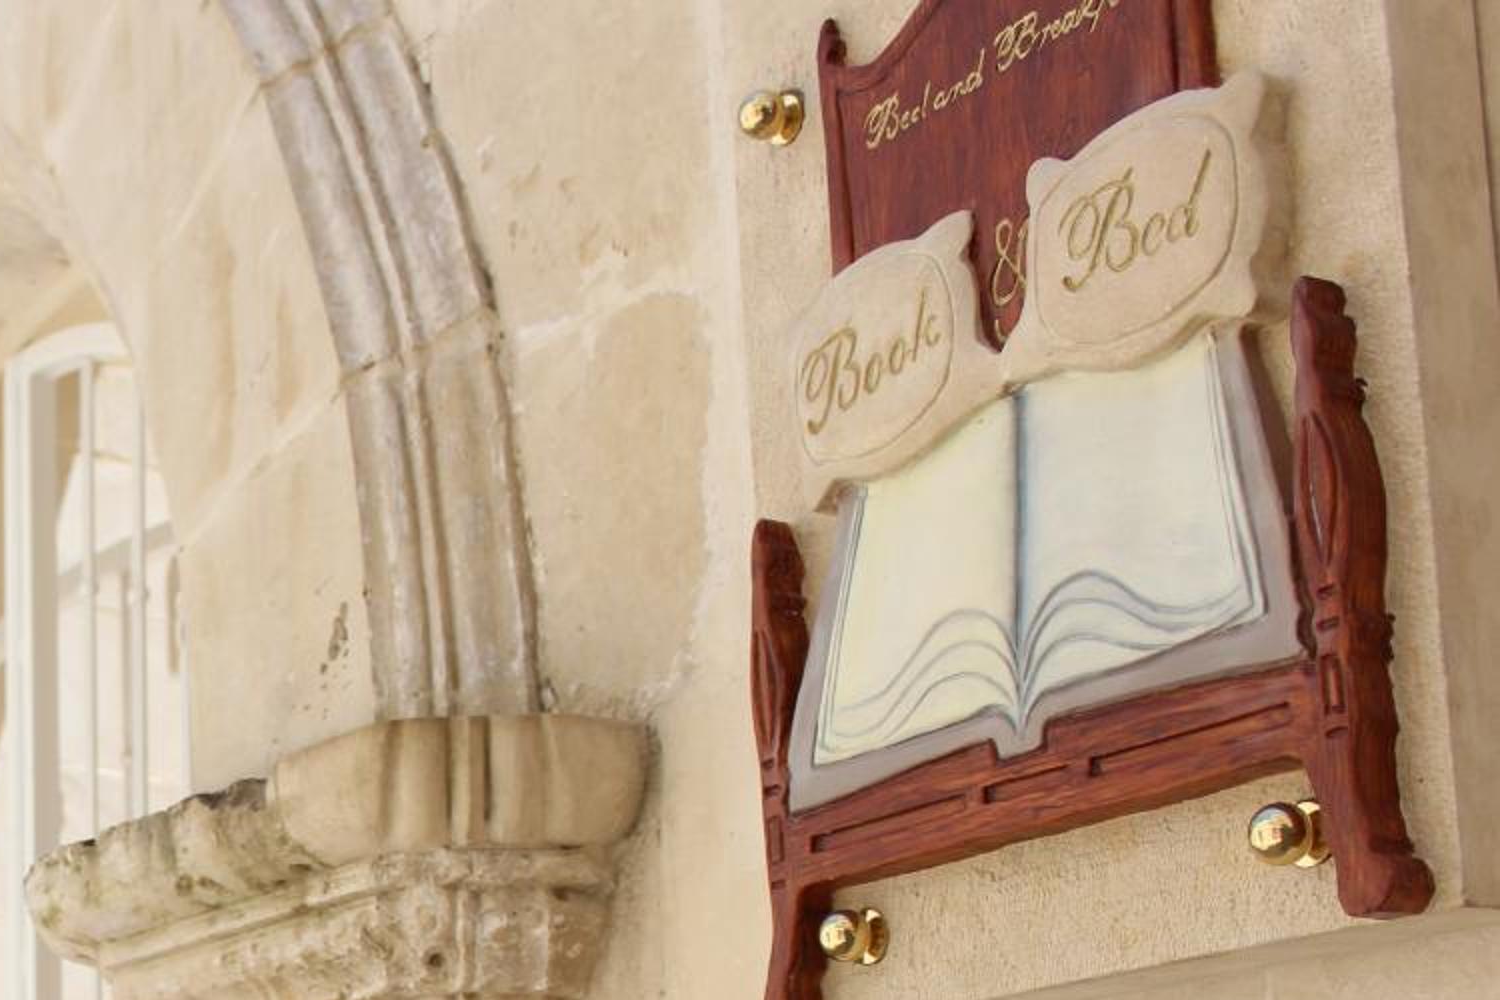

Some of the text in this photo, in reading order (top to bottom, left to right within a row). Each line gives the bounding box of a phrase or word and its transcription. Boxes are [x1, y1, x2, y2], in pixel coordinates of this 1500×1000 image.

[933, 49, 985, 110] and
[804, 148, 1212, 434] Book & Bed
